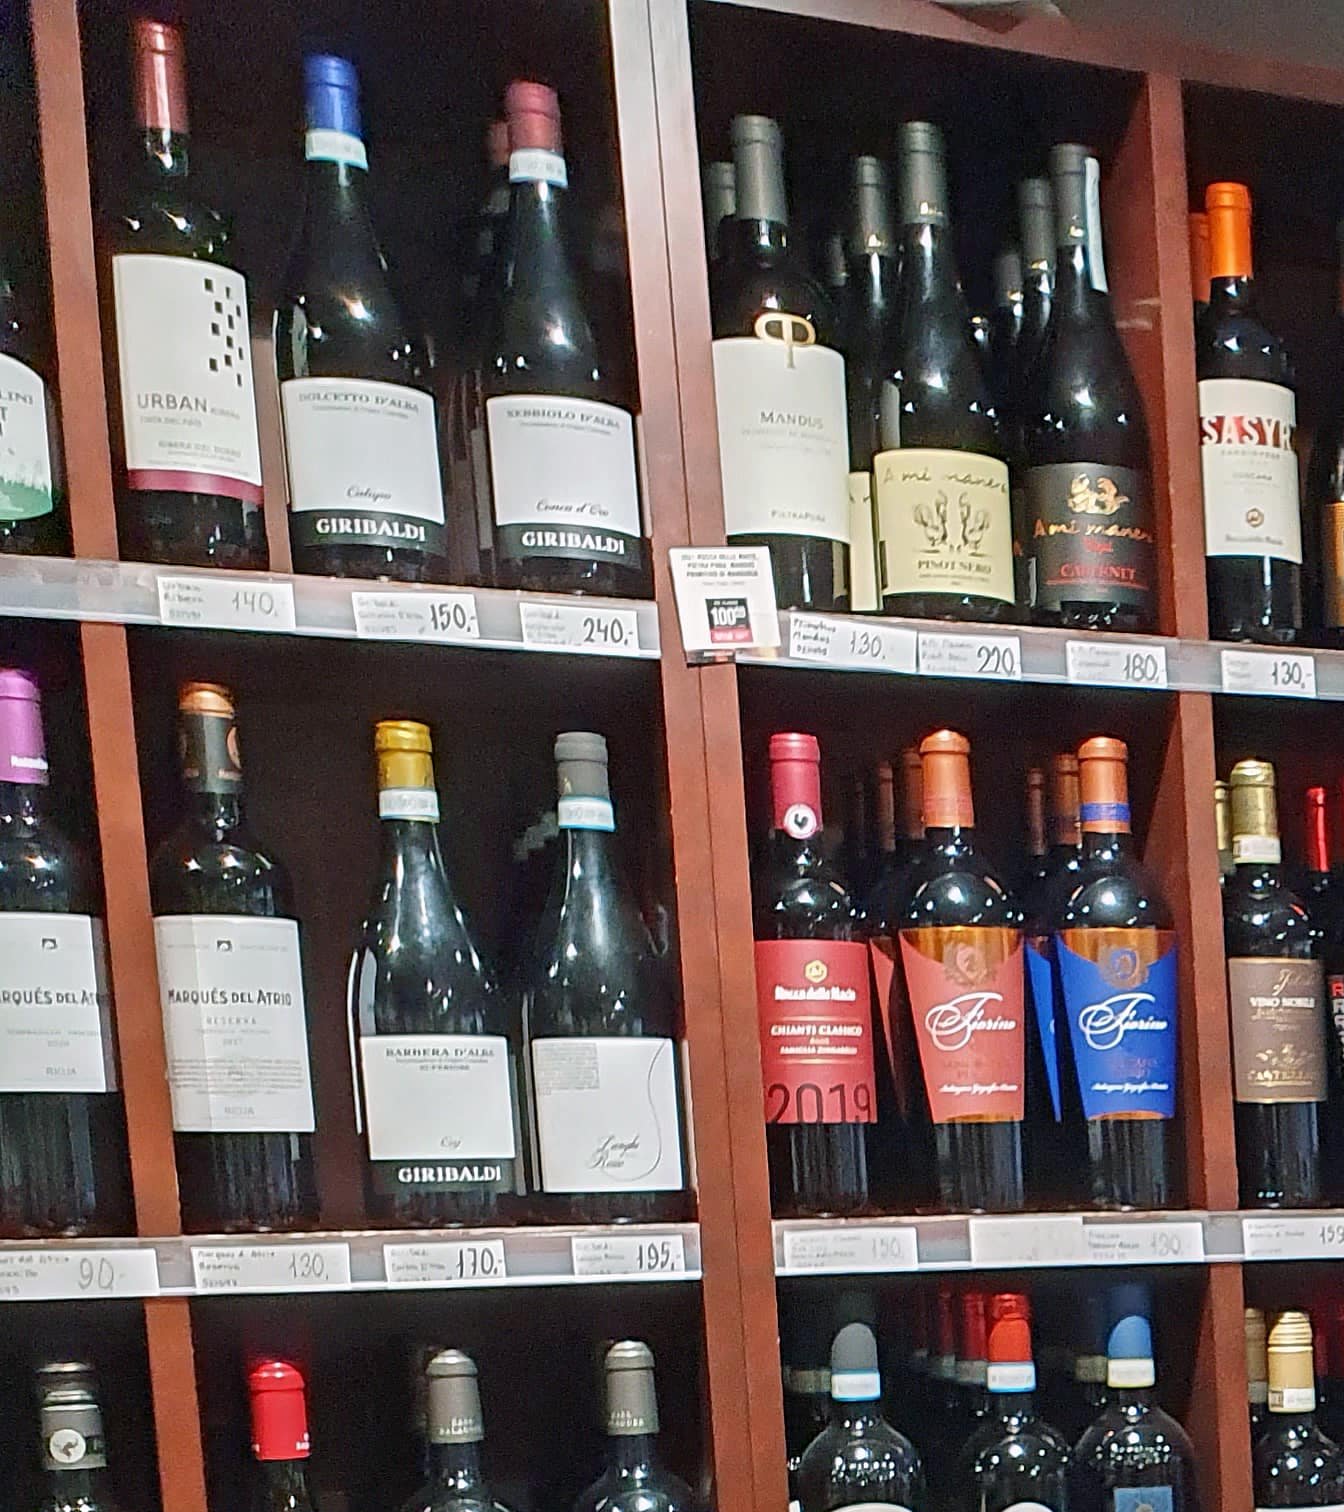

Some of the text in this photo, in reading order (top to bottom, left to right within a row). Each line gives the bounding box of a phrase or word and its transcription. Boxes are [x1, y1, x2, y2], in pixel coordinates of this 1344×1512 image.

[137, 394, 208, 413] URBAN
[761, 410, 824, 430] MANDUS
[316, 518, 426, 543] GIRIBALDI
[522, 531, 625, 556] GIRIBALDI
[168, 986, 229, 1006] MARQUÉS
[257, 990, 292, 1006] ATRIO
[767, 1082, 872, 1123] 2019
[398, 1165, 502, 1184] GIRIBALDI
